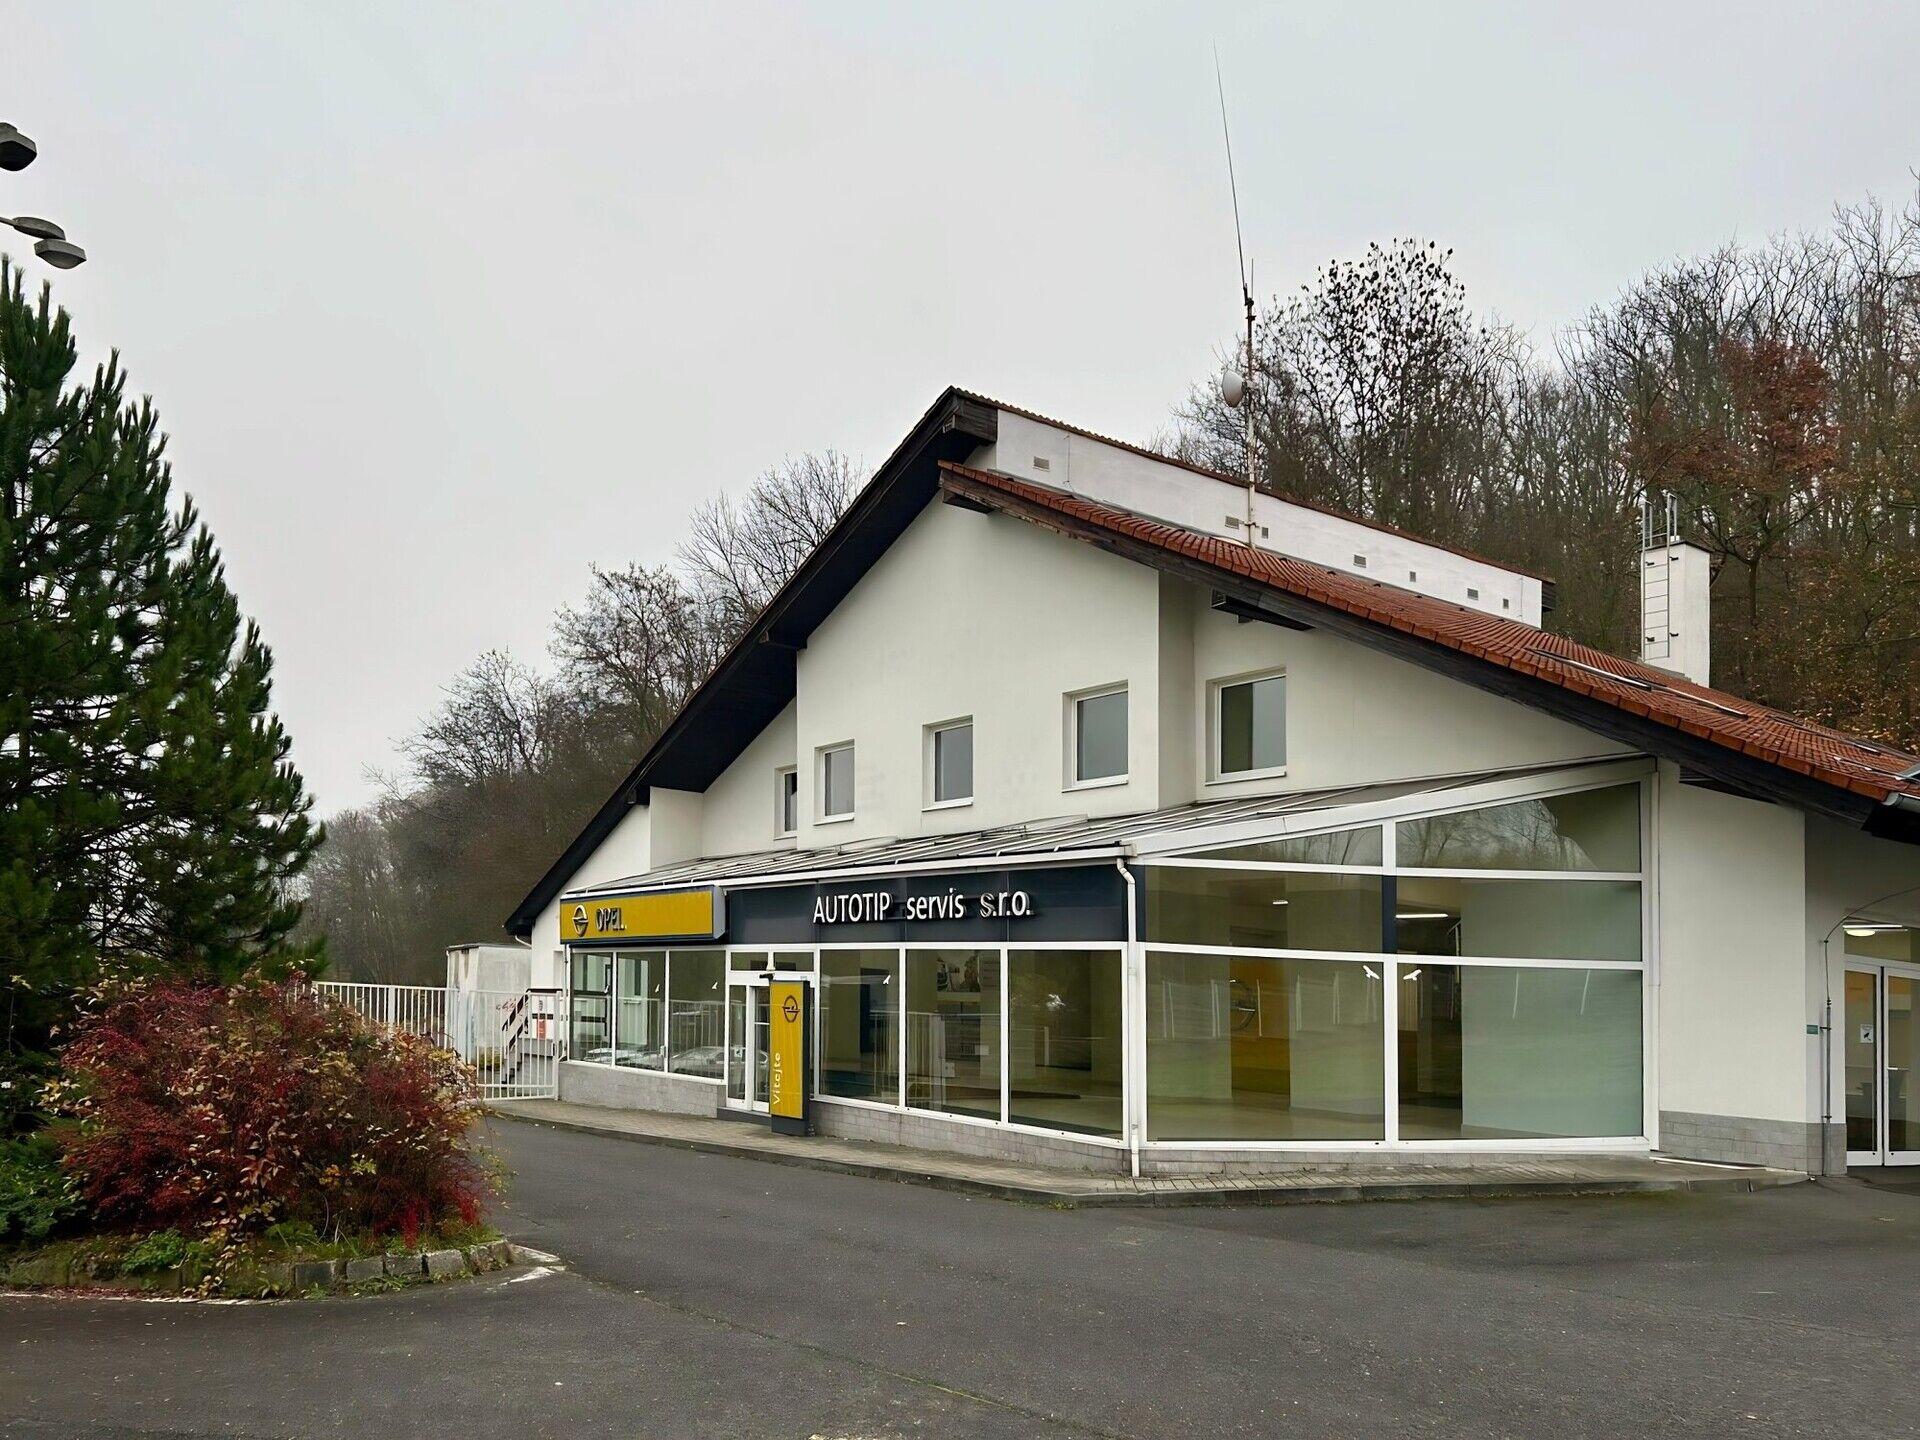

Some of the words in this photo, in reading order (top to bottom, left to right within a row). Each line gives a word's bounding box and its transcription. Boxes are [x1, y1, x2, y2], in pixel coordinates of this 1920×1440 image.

[595, 907, 626, 932] OPEL
[812, 892, 891, 924] AUTOTIP
[906, 887, 965, 920] servis
[979, 890, 1032, 918] s.r.o.
